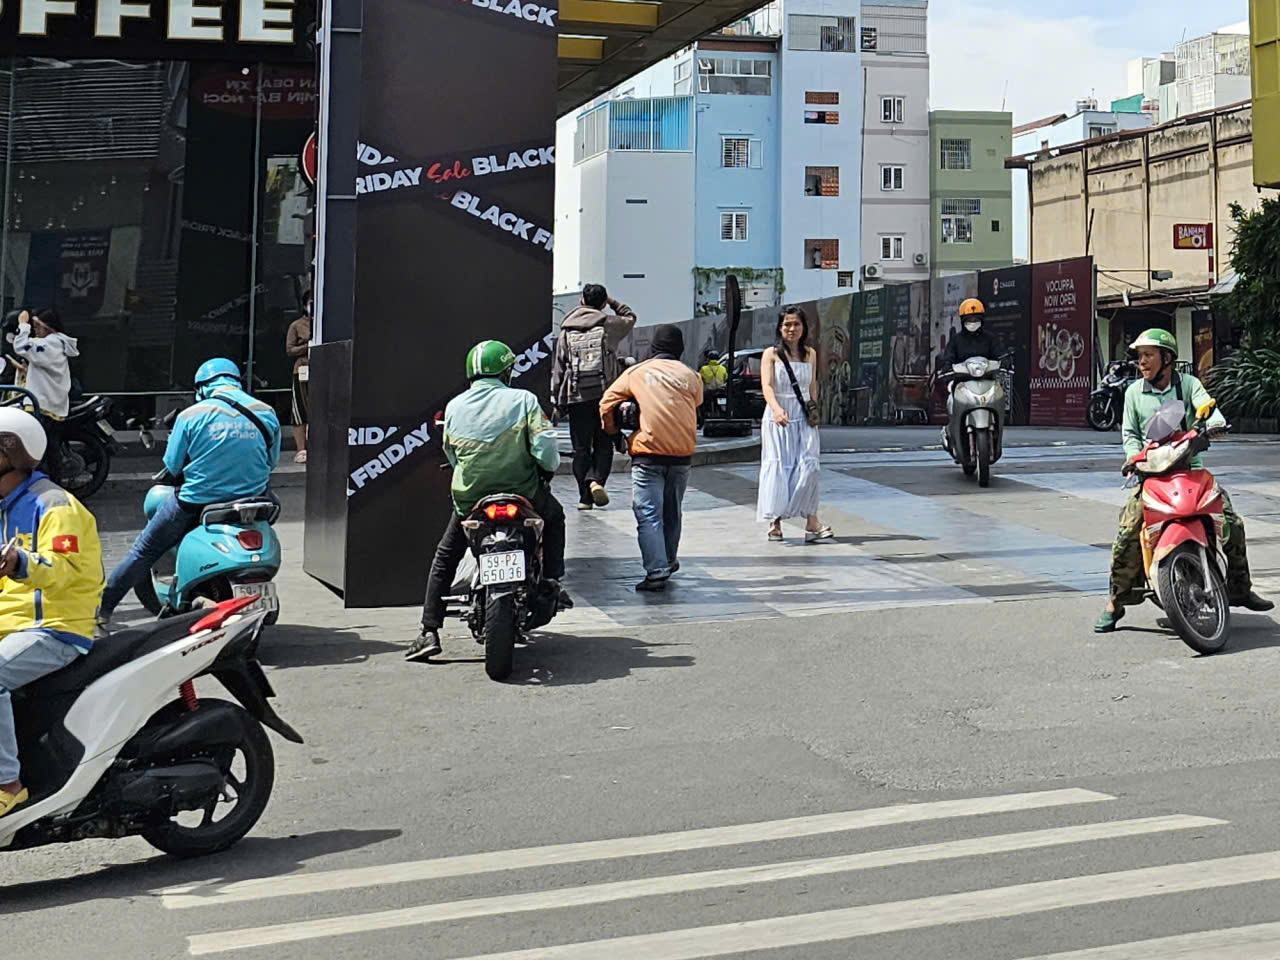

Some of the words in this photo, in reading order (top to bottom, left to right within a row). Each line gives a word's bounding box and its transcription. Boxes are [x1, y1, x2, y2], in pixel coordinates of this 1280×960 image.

[426, 160, 471, 183] Sale
[472, 145, 555, 176] BLACK
[450, 190, 536, 241] BLACK
[1044, 296, 1059, 307] NOW
[1060, 293, 1077, 305] OPEN
[350, 422, 431, 489] FRIDAY
[488, 553, 517, 568] 59-P2
